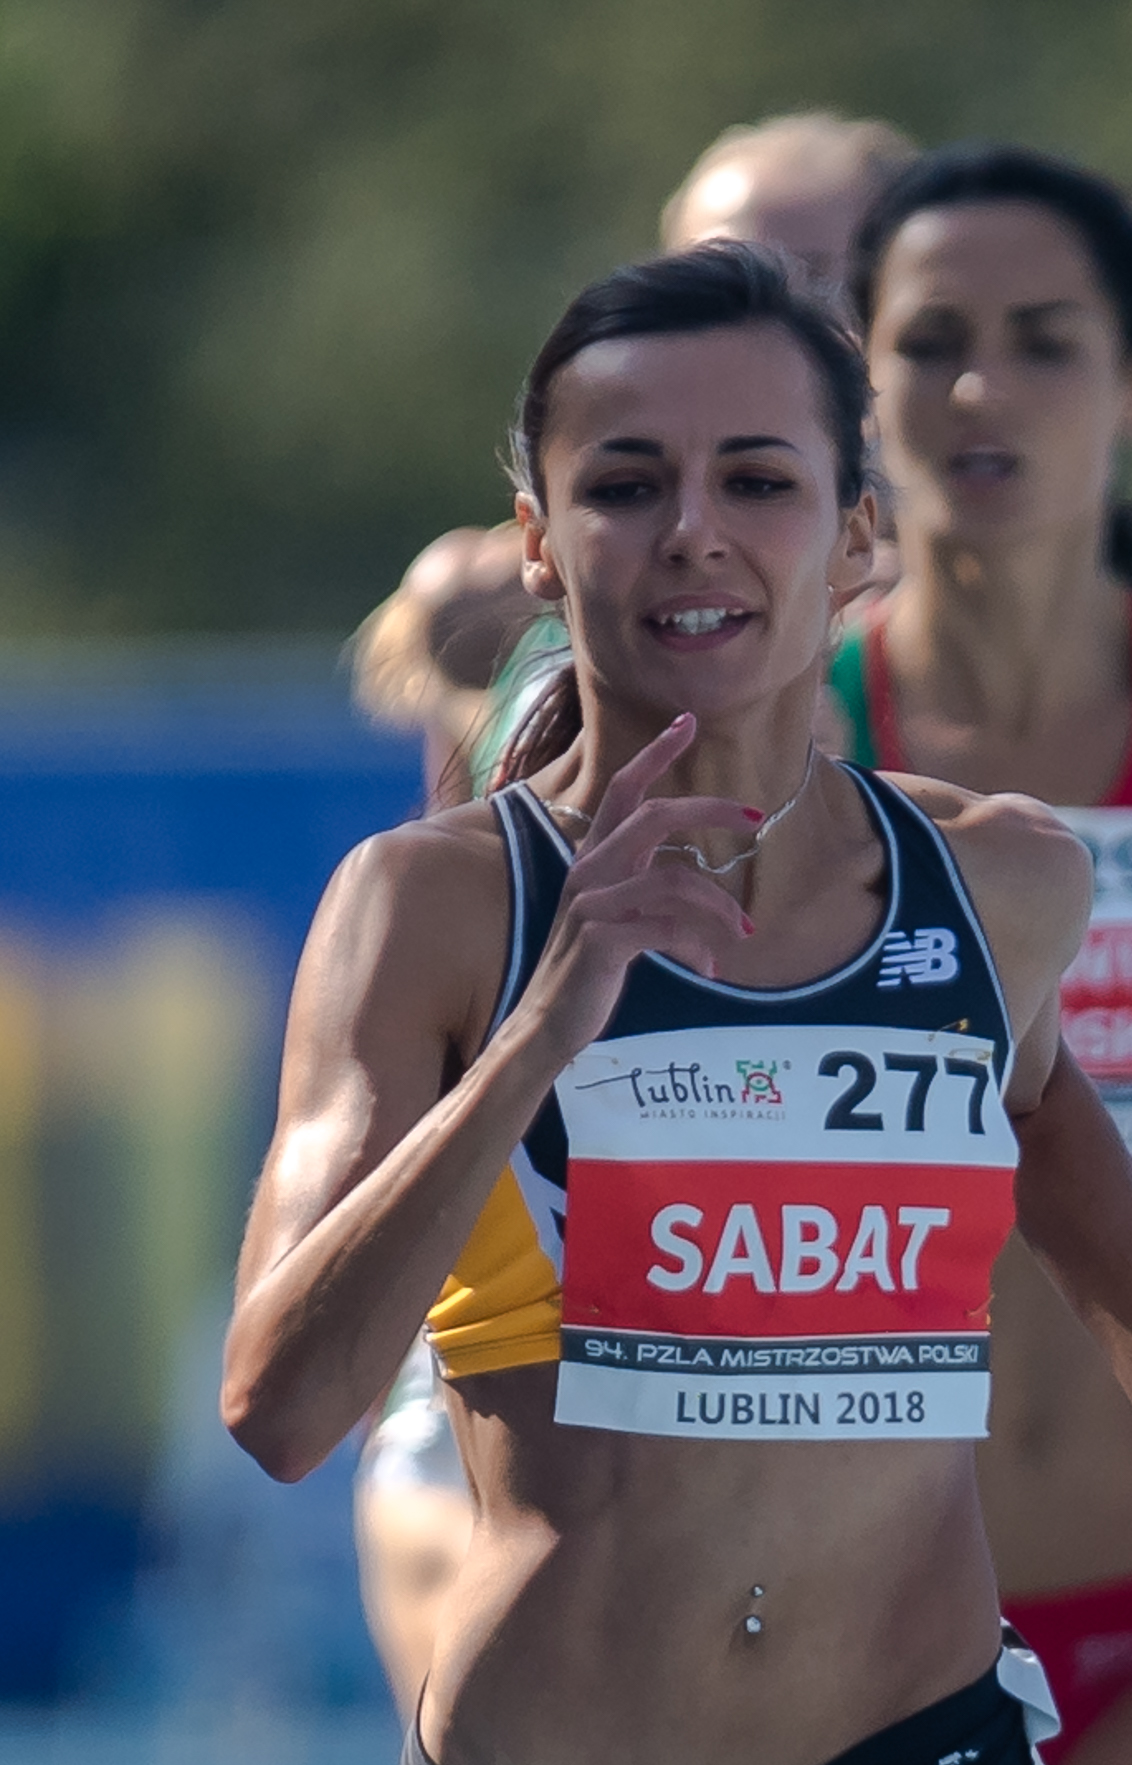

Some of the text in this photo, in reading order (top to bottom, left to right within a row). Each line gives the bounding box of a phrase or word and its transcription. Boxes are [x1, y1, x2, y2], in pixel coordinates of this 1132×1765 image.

[817, 1050, 990, 1135] 277
[646, 1203, 951, 1293] SABAT
[584, 1339, 979, 1368] 94. PZLA MISTRZOSTWA POLSKI
[675, 1390, 926, 1425] LUBLIN 2018
